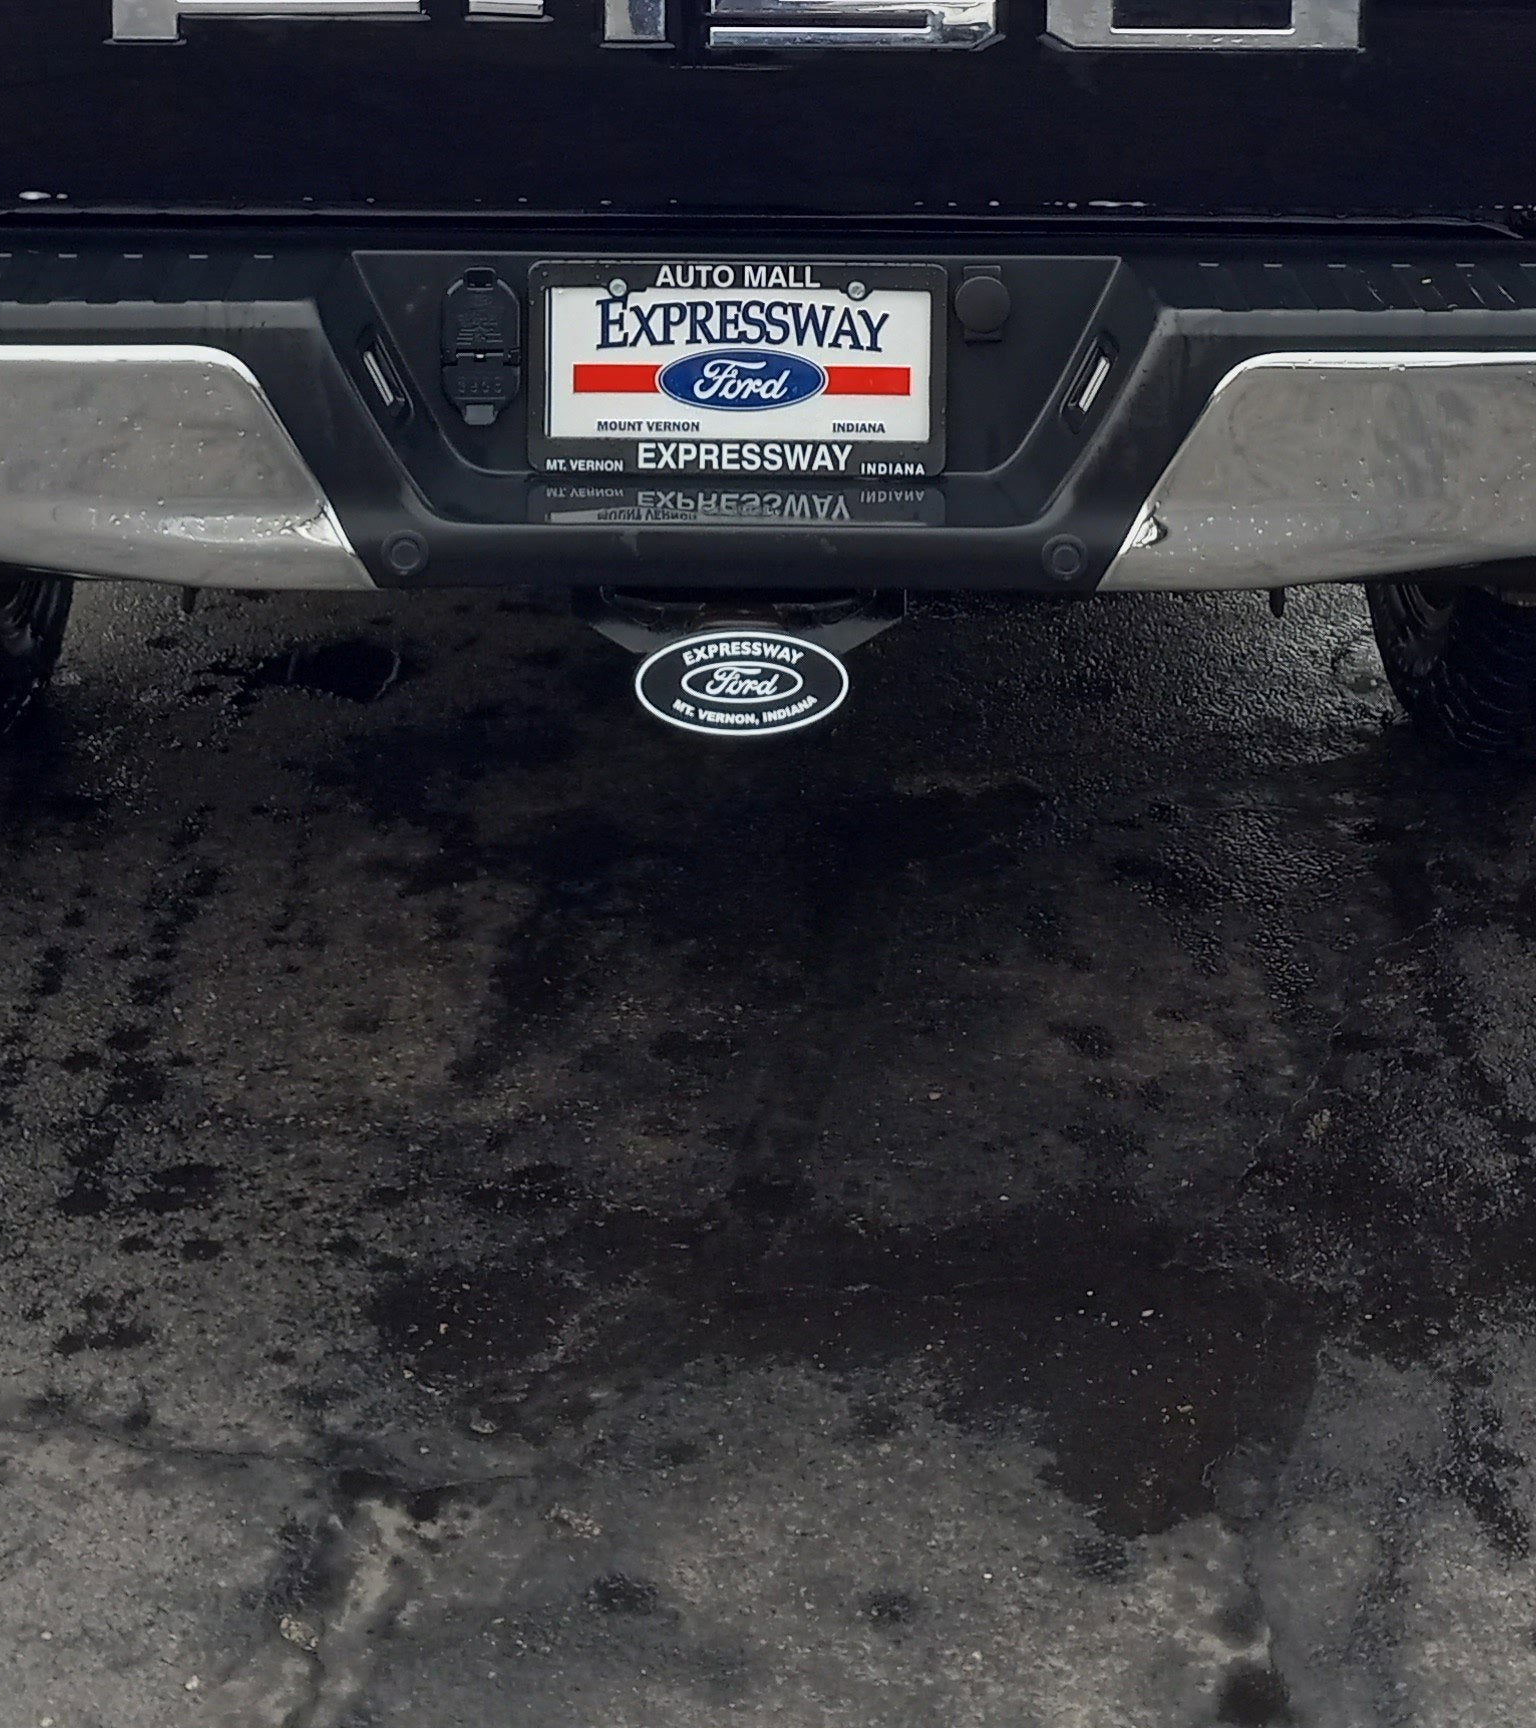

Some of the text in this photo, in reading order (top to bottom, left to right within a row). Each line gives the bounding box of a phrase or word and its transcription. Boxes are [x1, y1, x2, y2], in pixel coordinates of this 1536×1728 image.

[655, 266, 821, 288] AUTO MALL
[595, 296, 891, 353] EXPRESSWAY
[692, 358, 791, 401] Ford
[596, 420, 701, 433] MOUNT VERNON
[831, 422, 886, 434] INDIANA
[545, 459, 624, 472] MT. VERNON
[637, 443, 853, 471] EXPRESSWAY
[861, 463, 925, 476] INDIANA
[682, 642, 805, 665] EXPRESSWAY
[705, 667, 780, 697] Ford
[672, 695, 818, 725] MT. VERNON, INDIANA
